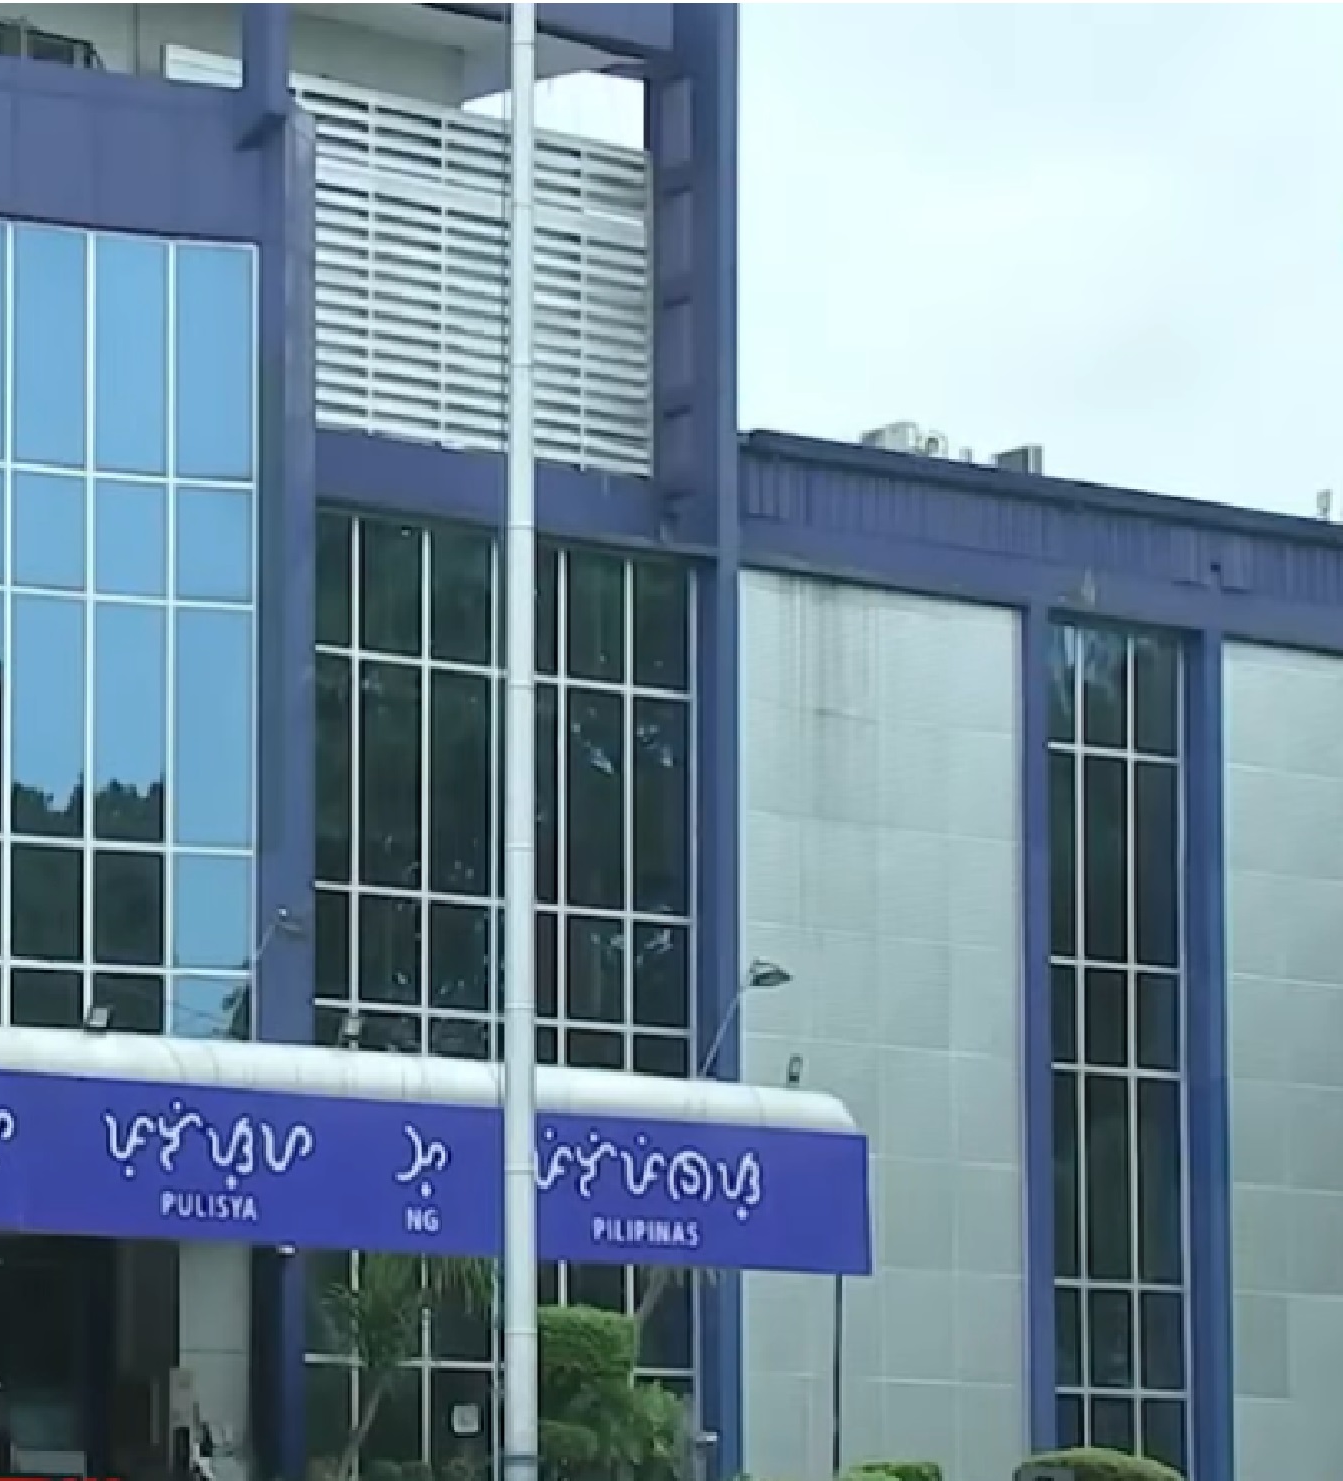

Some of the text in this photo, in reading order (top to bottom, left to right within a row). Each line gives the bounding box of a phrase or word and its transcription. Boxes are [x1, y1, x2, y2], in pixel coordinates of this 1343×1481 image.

[160, 1189, 258, 1222] PULISYA
[406, 1207, 441, 1232] NG
[592, 1216, 700, 1247] PILIPINAS
